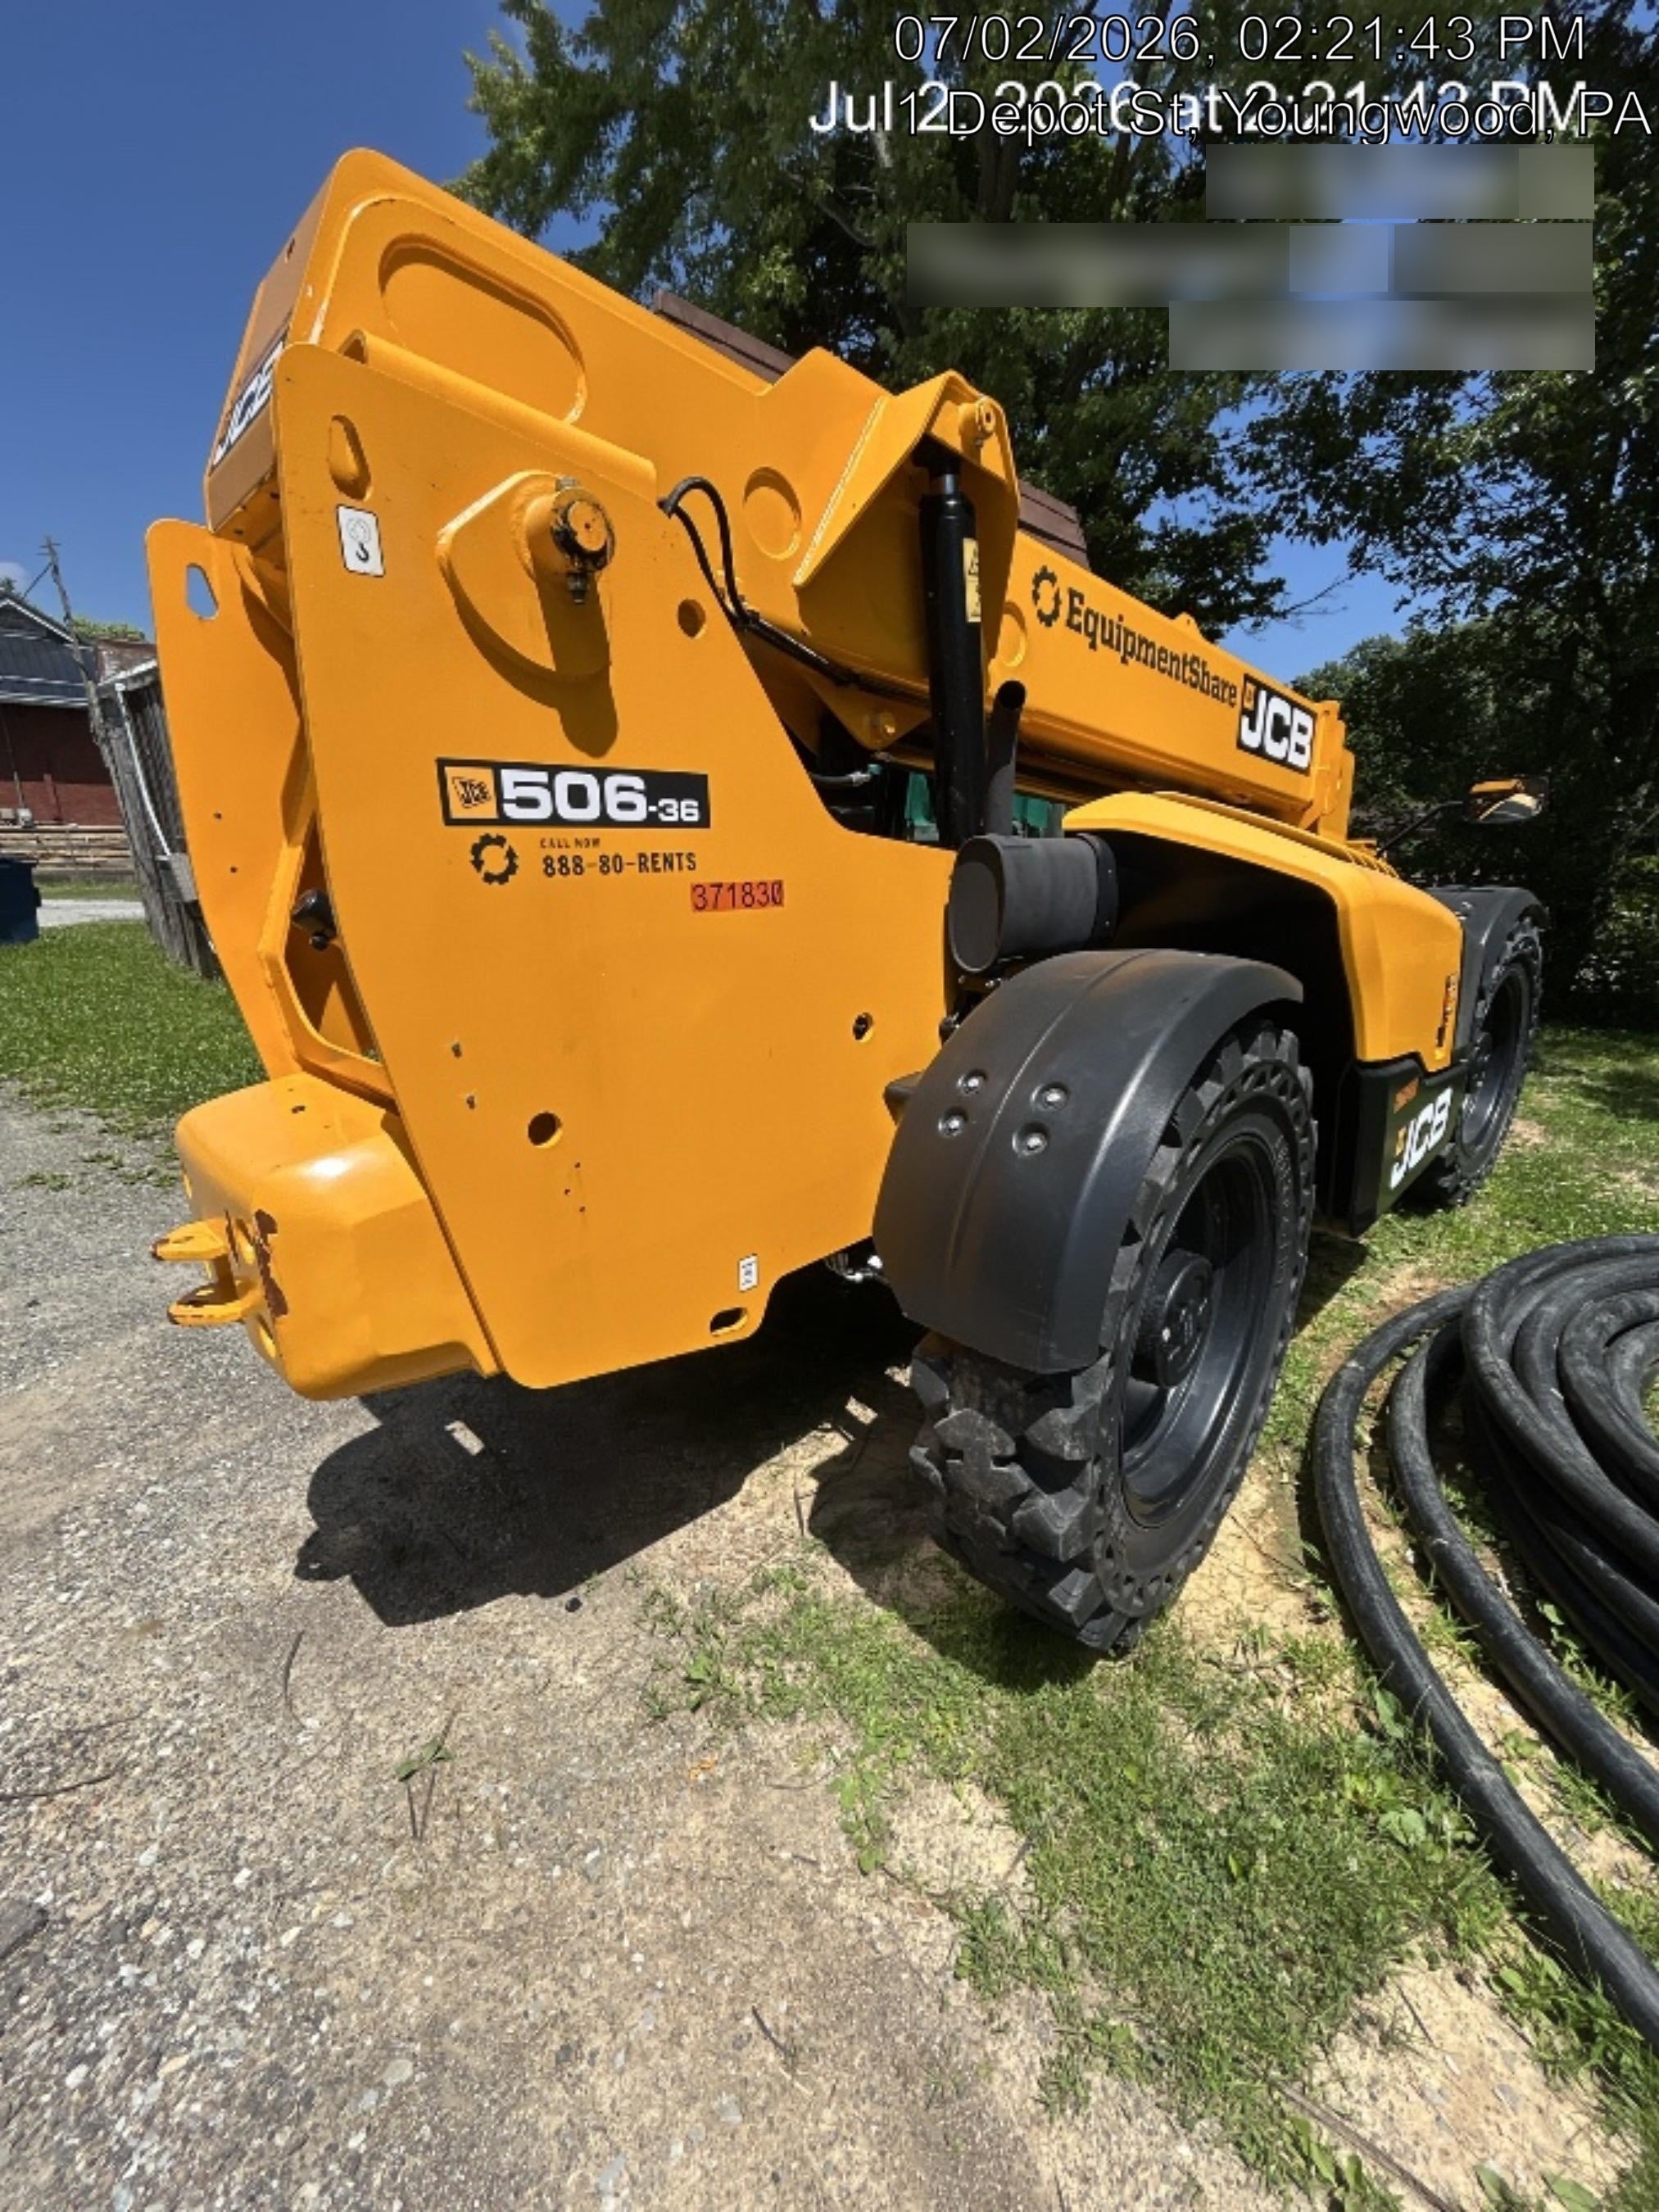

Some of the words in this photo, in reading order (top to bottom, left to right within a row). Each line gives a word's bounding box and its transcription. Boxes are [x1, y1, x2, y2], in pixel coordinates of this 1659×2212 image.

[1067, 587, 1238, 709] EquipmentShare
[1241, 688, 1314, 770] JCB
[500, 768, 700, 823] 506-36
[540, 837, 571, 849] CALL
[574, 837, 601, 849] NOW
[542, 852, 697, 878] 888-80-RENTS
[692, 880, 784, 911] 371830
[1390, 1086, 1453, 1190] JCB
